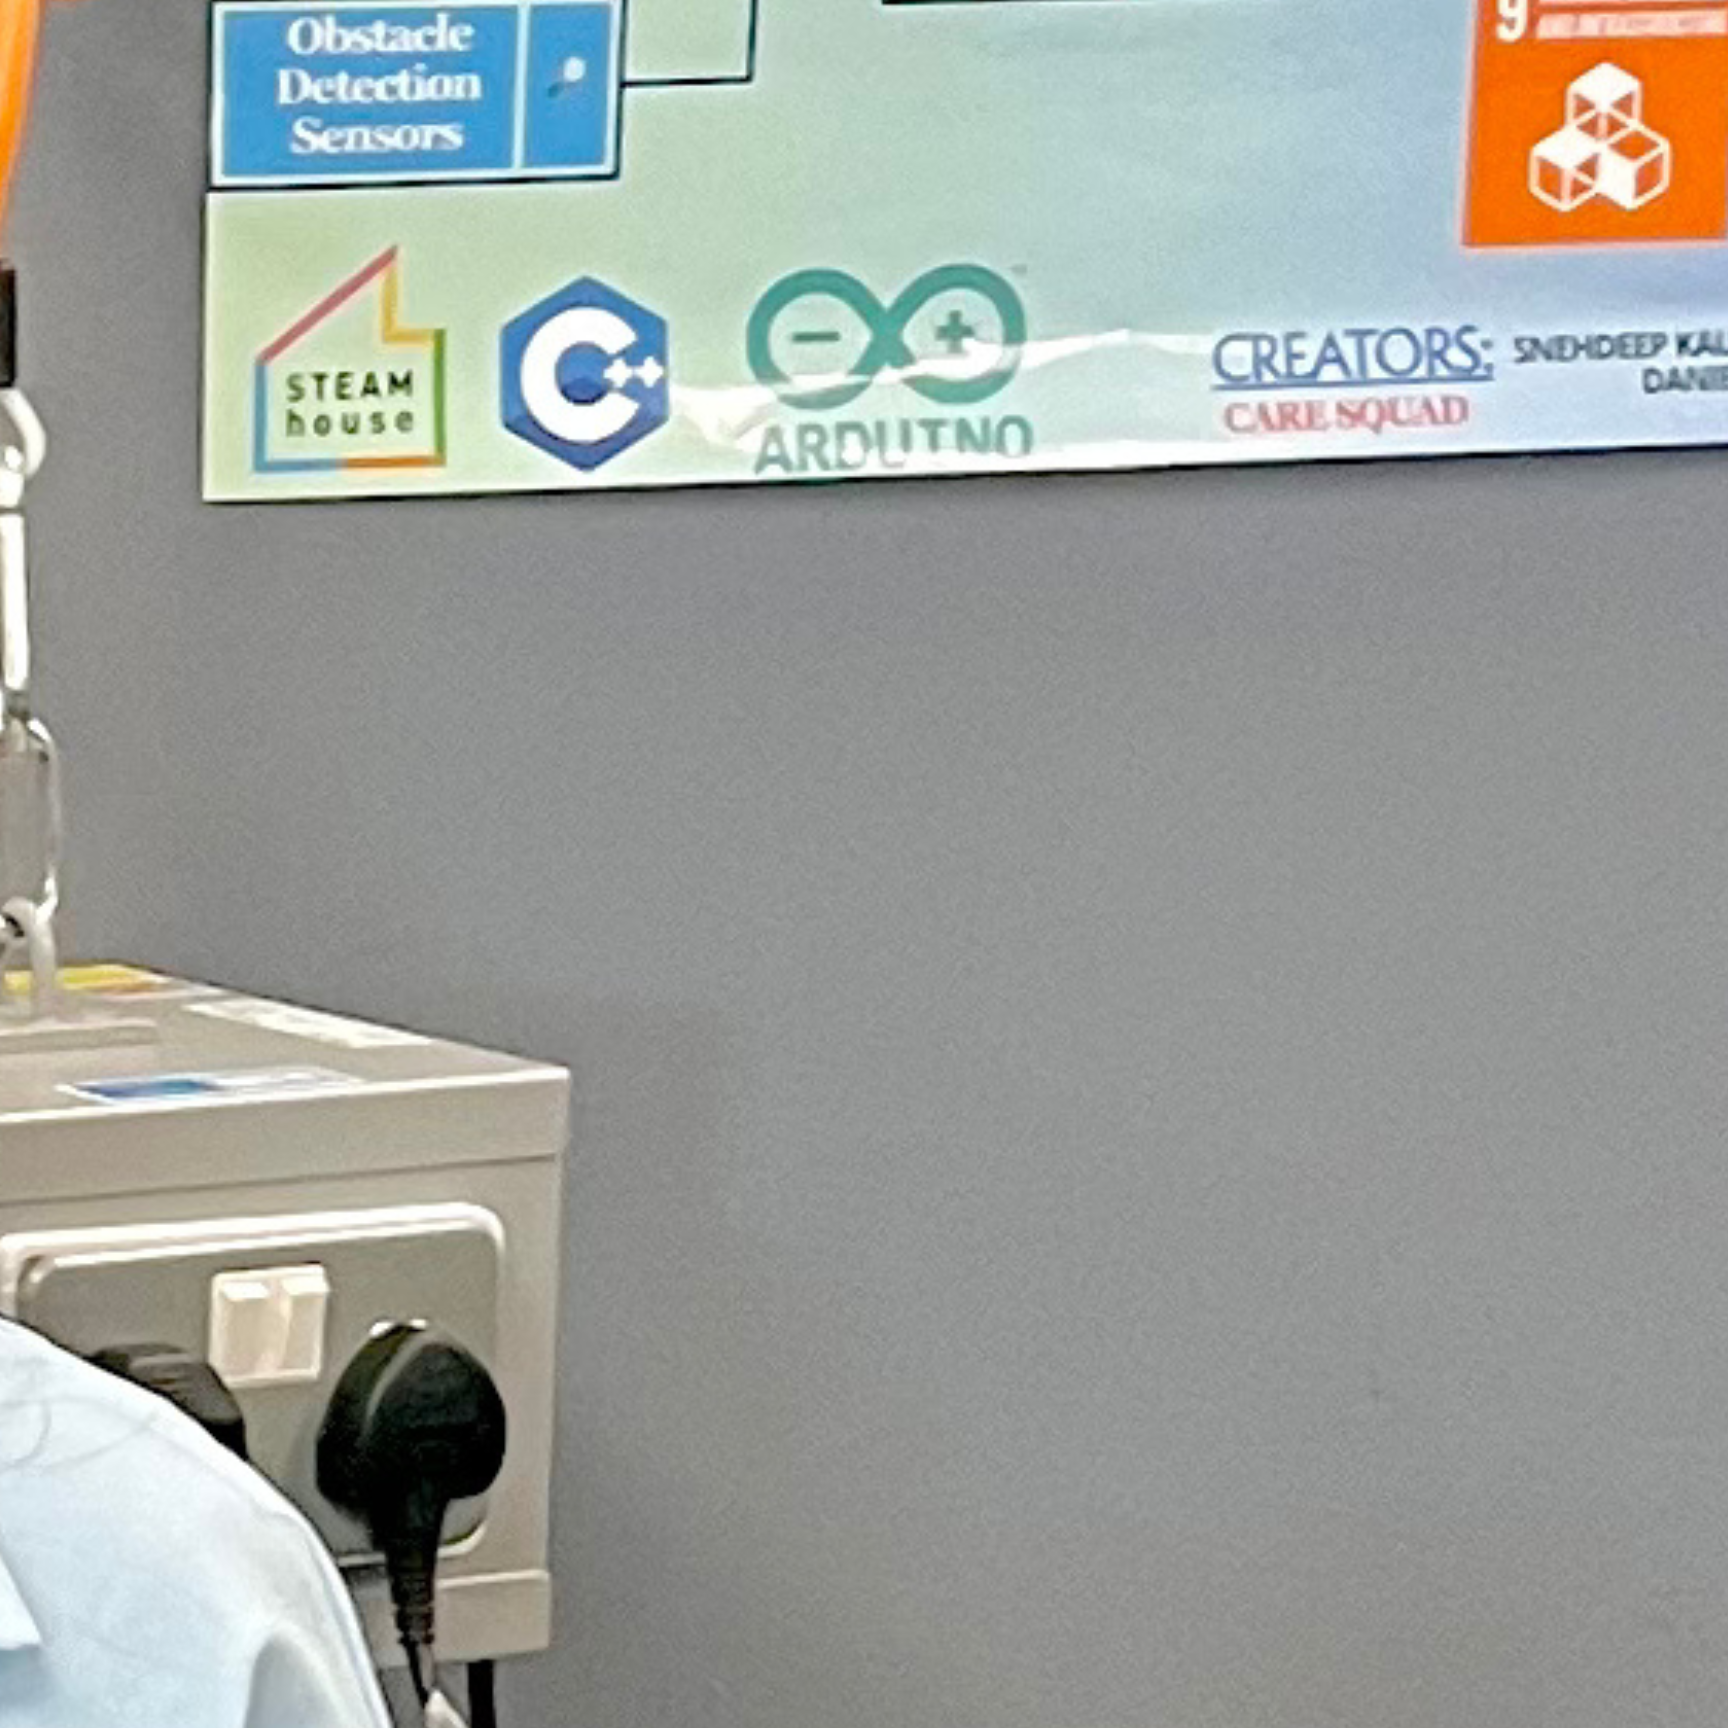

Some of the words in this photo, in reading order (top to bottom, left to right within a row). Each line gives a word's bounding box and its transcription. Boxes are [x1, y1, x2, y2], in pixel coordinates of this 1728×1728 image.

[287, 12, 476, 54] Obstacle
[1497, 0, 1527, 43] 9
[277, 63, 481, 104] Detection
[291, 116, 464, 154] Sensors
[521, 307, 665, 441] C++
[1212, 325, 1494, 384] CREATORS:
[285, 369, 414, 402] STEAM
[285, 408, 414, 437] house
[1224, 401, 1326, 433] CARE
[1335, 396, 1469, 434] SQUAD
